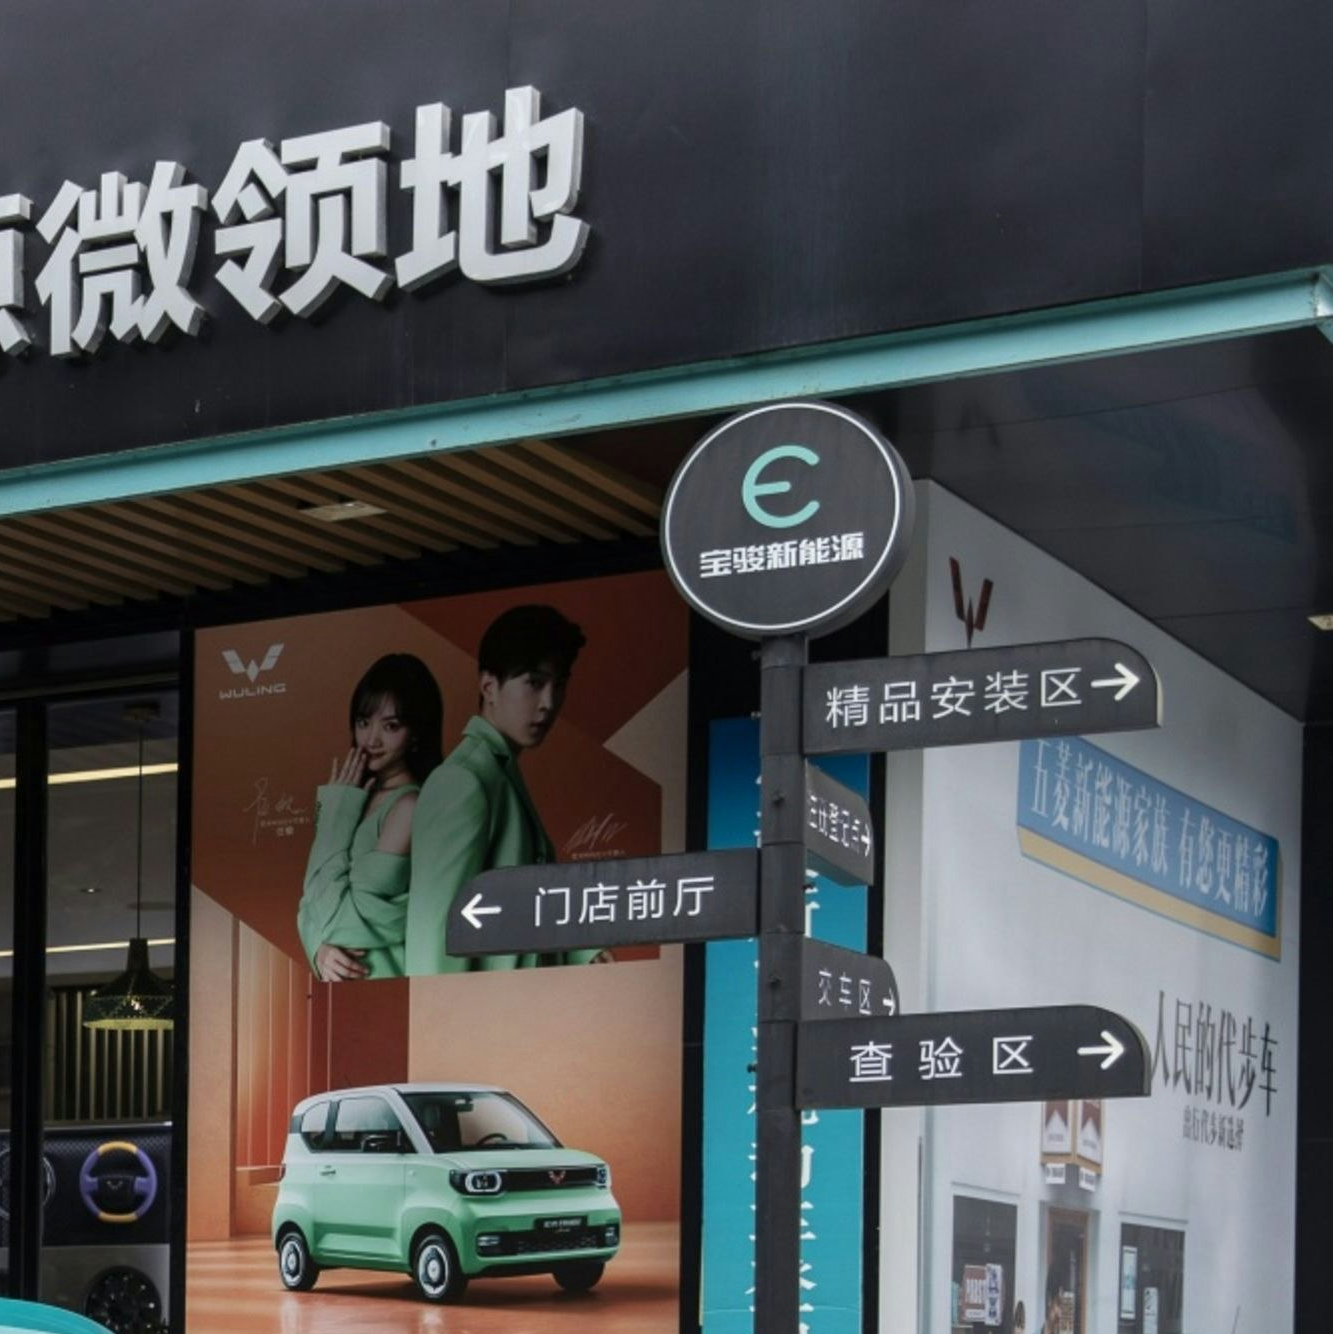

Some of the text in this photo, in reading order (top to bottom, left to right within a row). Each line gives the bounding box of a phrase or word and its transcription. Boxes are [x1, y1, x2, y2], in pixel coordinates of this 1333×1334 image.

[700, 532, 864, 578] 宝骏新能源
[219, 683, 287, 700] WULING
[825, 667, 1084, 727] 精品安装区
[1031, 739, 1269, 916] 五菱新能源家族 有您更精彩
[533, 875, 716, 927] 门店前厅
[818, 968, 872, 1014] 交车区
[849, 1035, 1034, 1084] 查验区
[1151, 990, 1279, 1117] 人民的代步车
